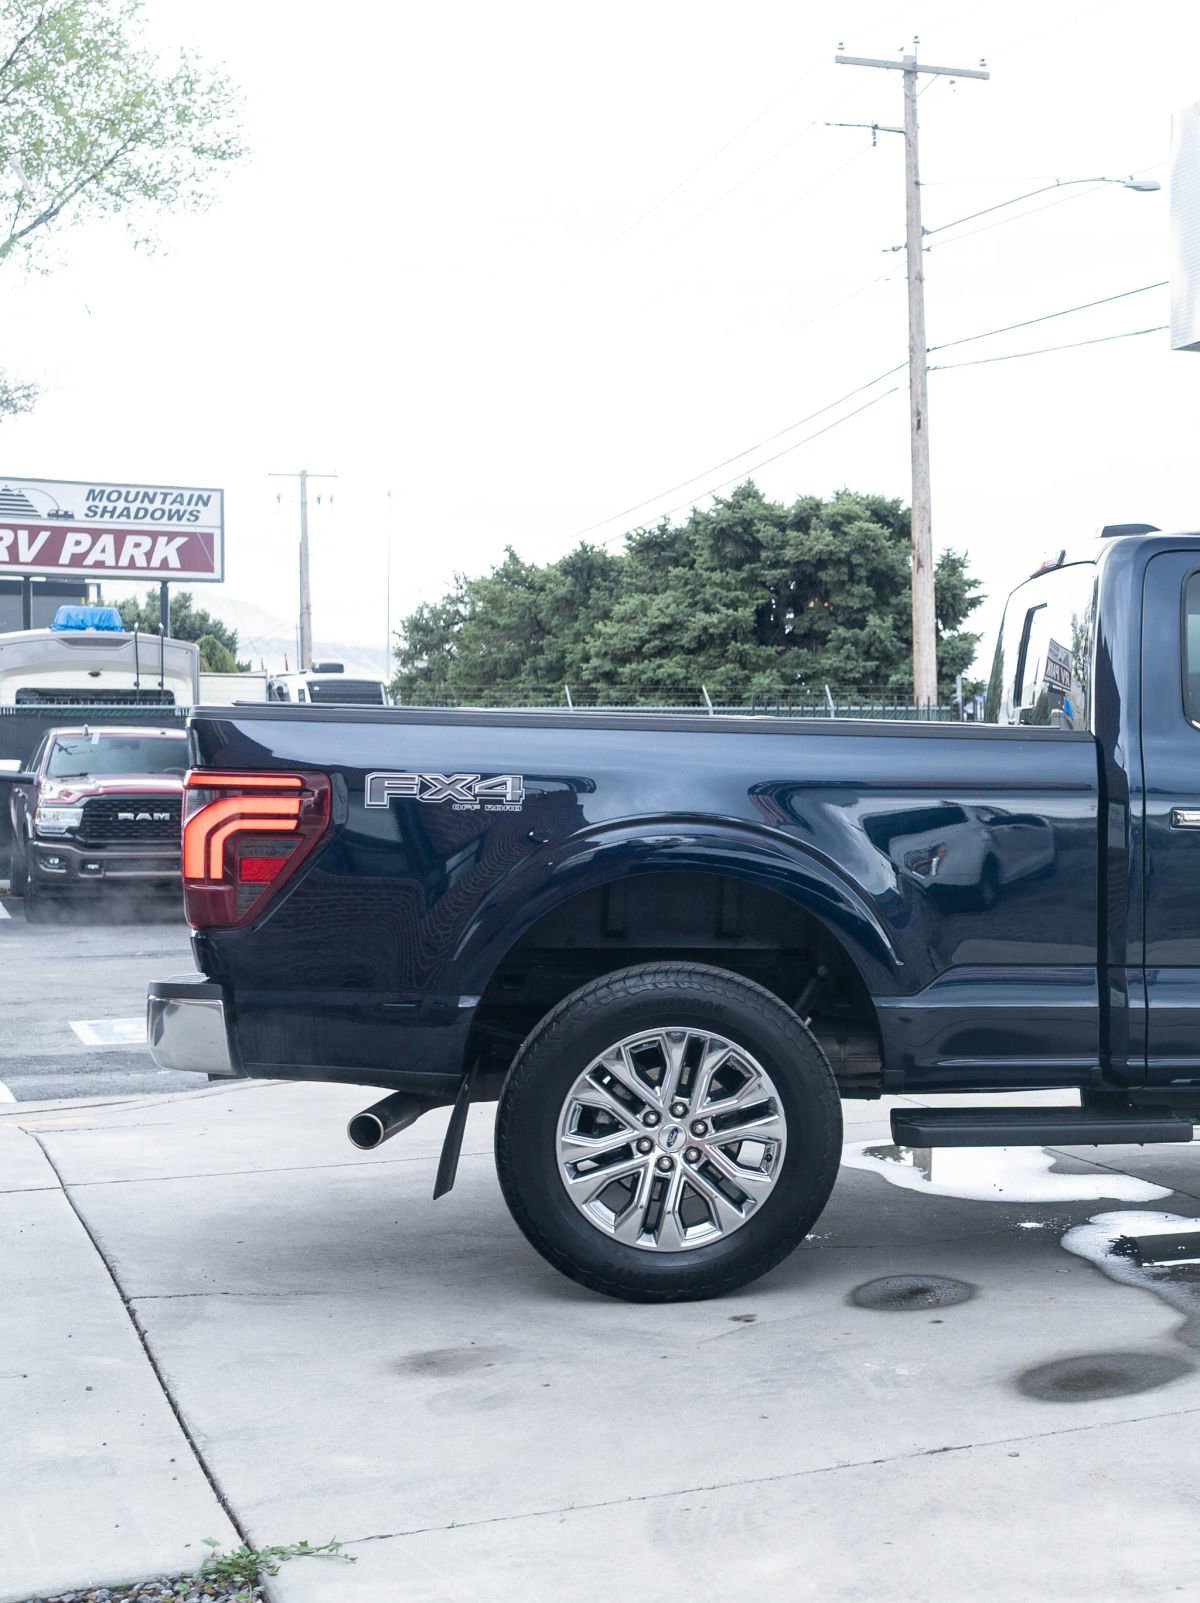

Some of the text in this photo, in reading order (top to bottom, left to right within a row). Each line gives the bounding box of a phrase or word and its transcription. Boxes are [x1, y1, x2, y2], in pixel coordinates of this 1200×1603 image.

[84, 488, 213, 508] MOUNTAIN
[84, 504, 202, 523] SHADOWS
[58, 532, 189, 569] PARK
[364, 771, 526, 809] FX4
[118, 812, 171, 820] RAM
